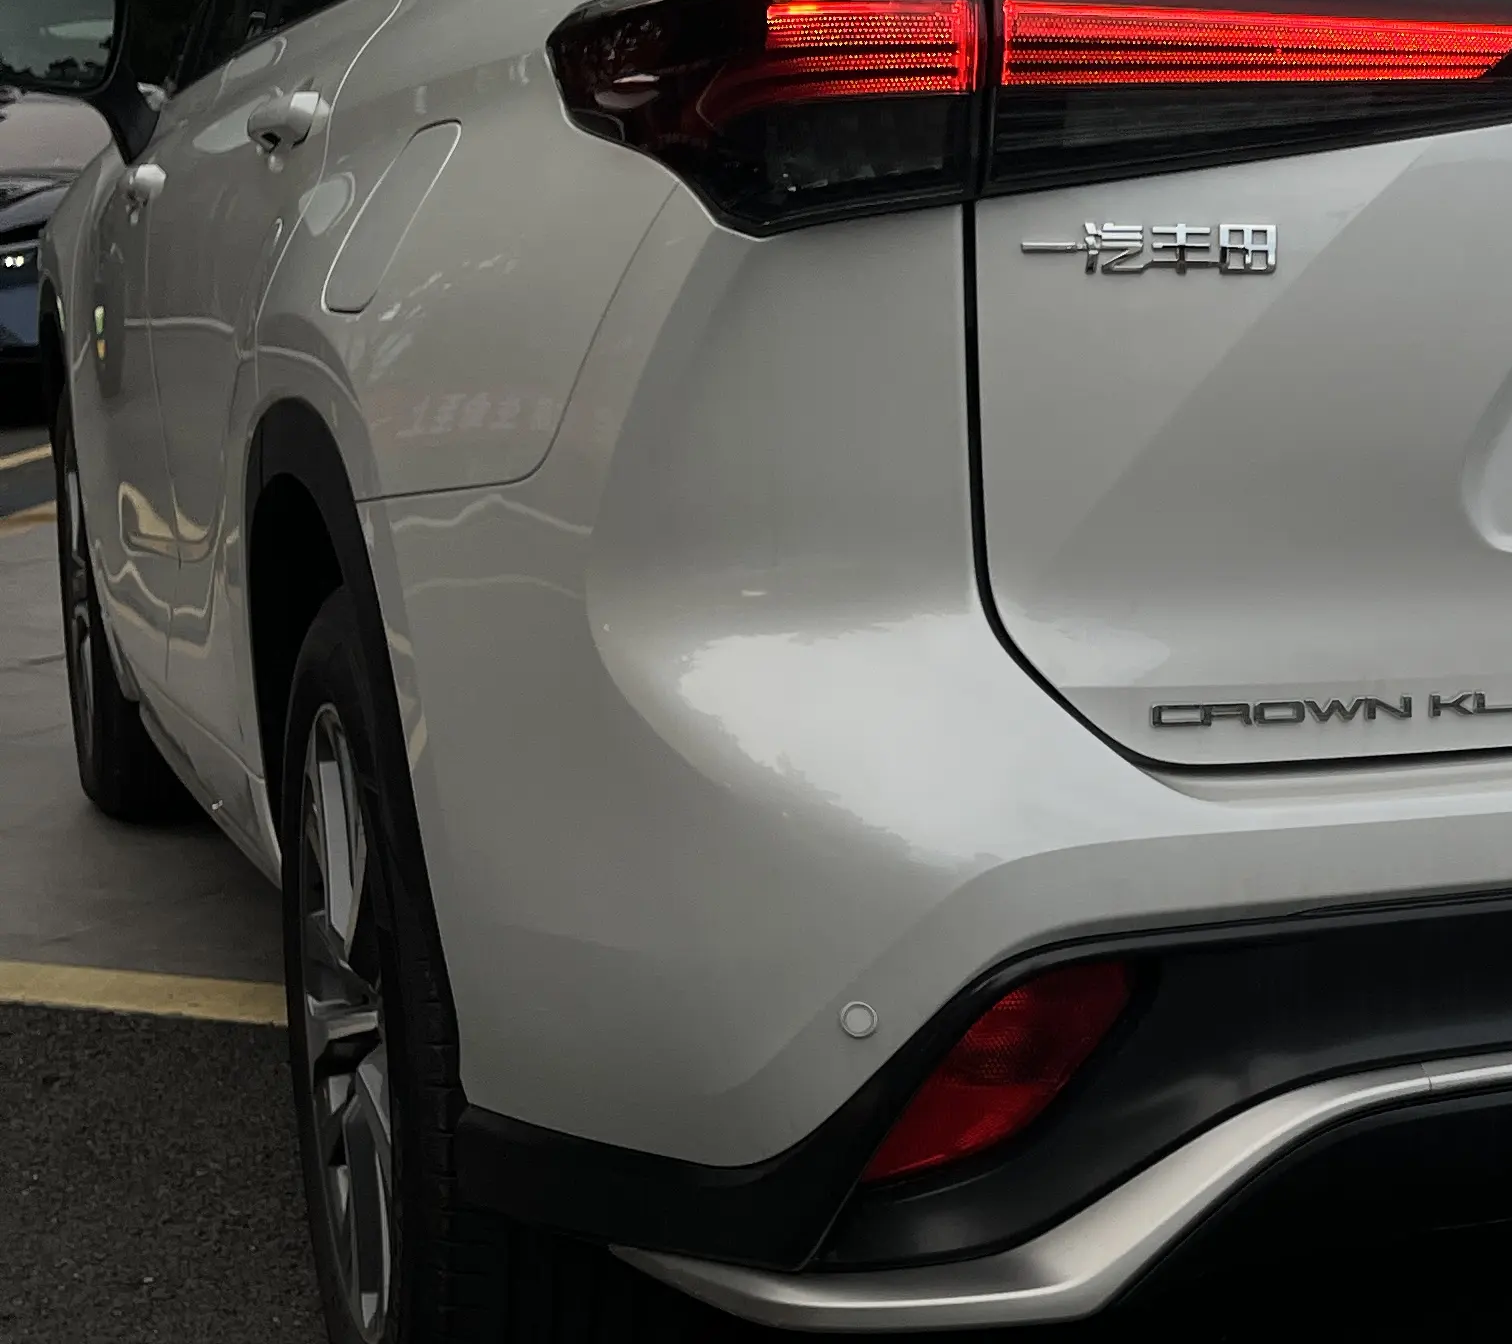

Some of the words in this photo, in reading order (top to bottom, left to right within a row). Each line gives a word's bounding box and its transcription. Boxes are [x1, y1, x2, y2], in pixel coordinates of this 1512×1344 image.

[1021, 222, 1277, 274] 一汽丰田
[1150, 696, 1412, 729] CROWN
